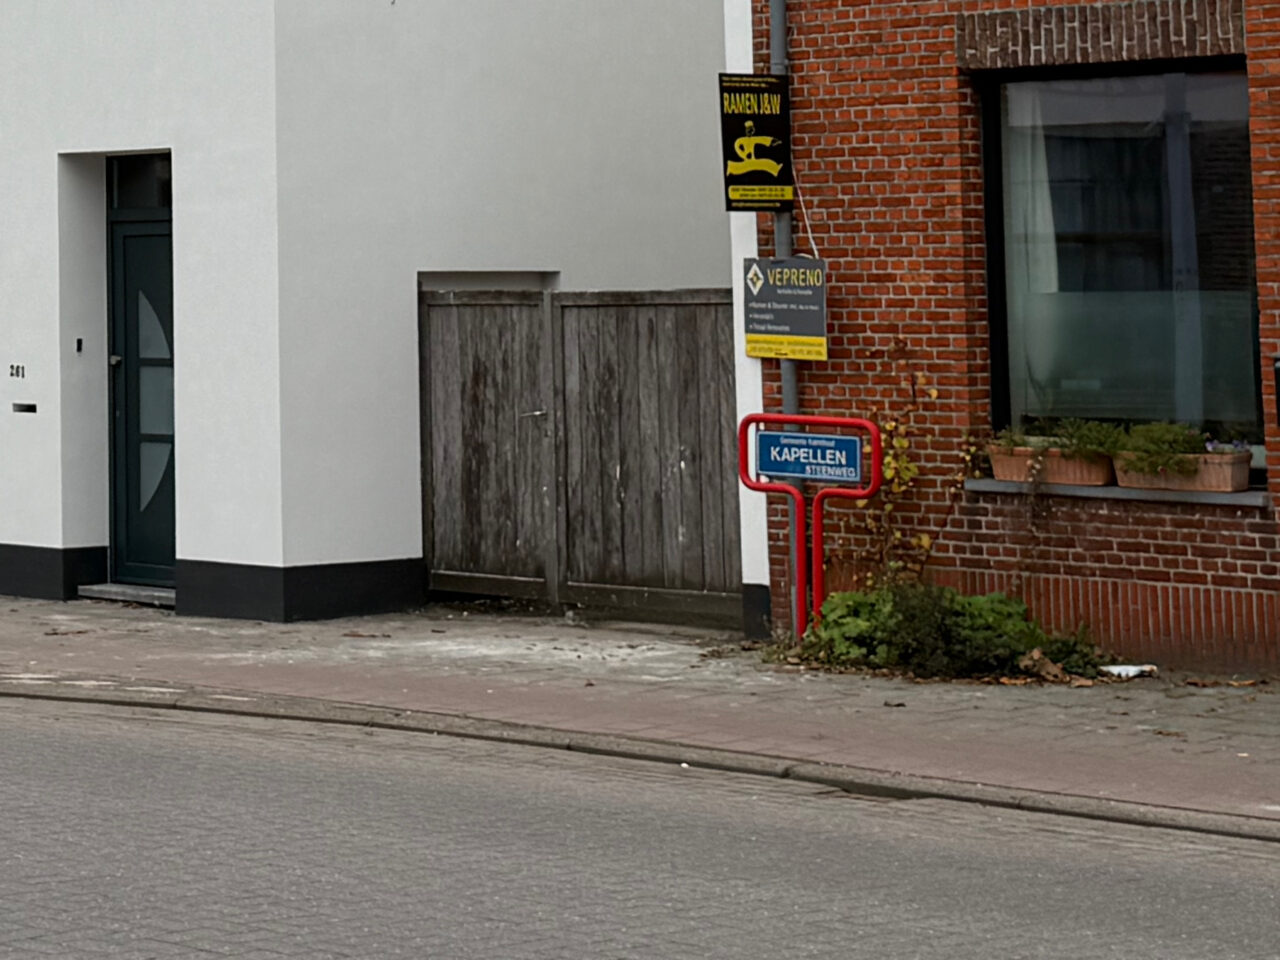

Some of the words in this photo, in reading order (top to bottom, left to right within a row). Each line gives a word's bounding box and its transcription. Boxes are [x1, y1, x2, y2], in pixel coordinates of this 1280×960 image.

[723, 93, 758, 114] RAMEN
[760, 93, 781, 114] J&W
[767, 268, 823, 287] VEPRENO
[770, 446, 846, 465] KAPELLEN
[805, 465, 856, 477] STEENWEG
